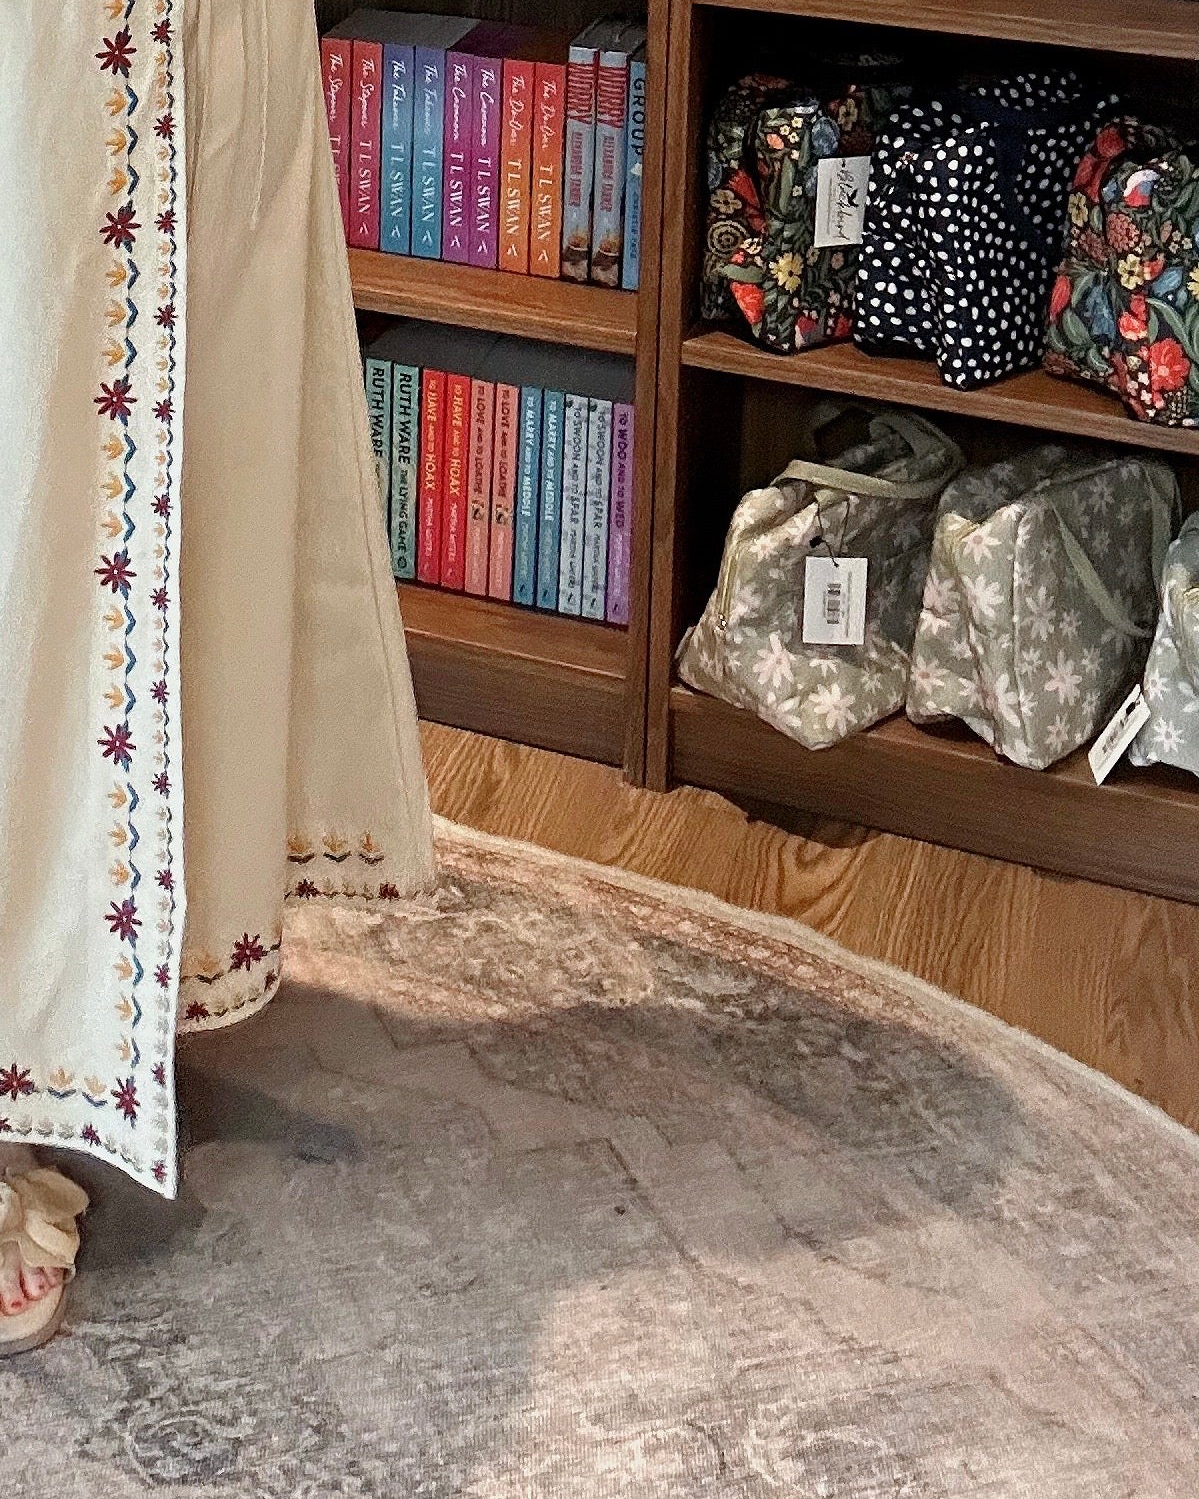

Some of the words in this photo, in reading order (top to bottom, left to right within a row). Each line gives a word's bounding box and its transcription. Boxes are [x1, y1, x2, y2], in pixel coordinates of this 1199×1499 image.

[631, 77, 645, 155] GROUP
[357, 169, 371, 214] SWAN
[390, 171, 403, 217] SWAN
[422, 175, 435, 222] SWAN
[450, 179, 463, 227] SWAN
[477, 185, 491, 233] SWAN
[507, 188, 521, 236] SWAN
[538, 194, 552, 241] SWAN
[372, 367, 385, 411] RUTH
[399, 372, 413, 416] RUTH
[372, 414, 384, 458] WARE
[398, 420, 412, 465] WARE
[425, 454, 436, 490] HOAX
[450, 459, 461, 495] HOAX
